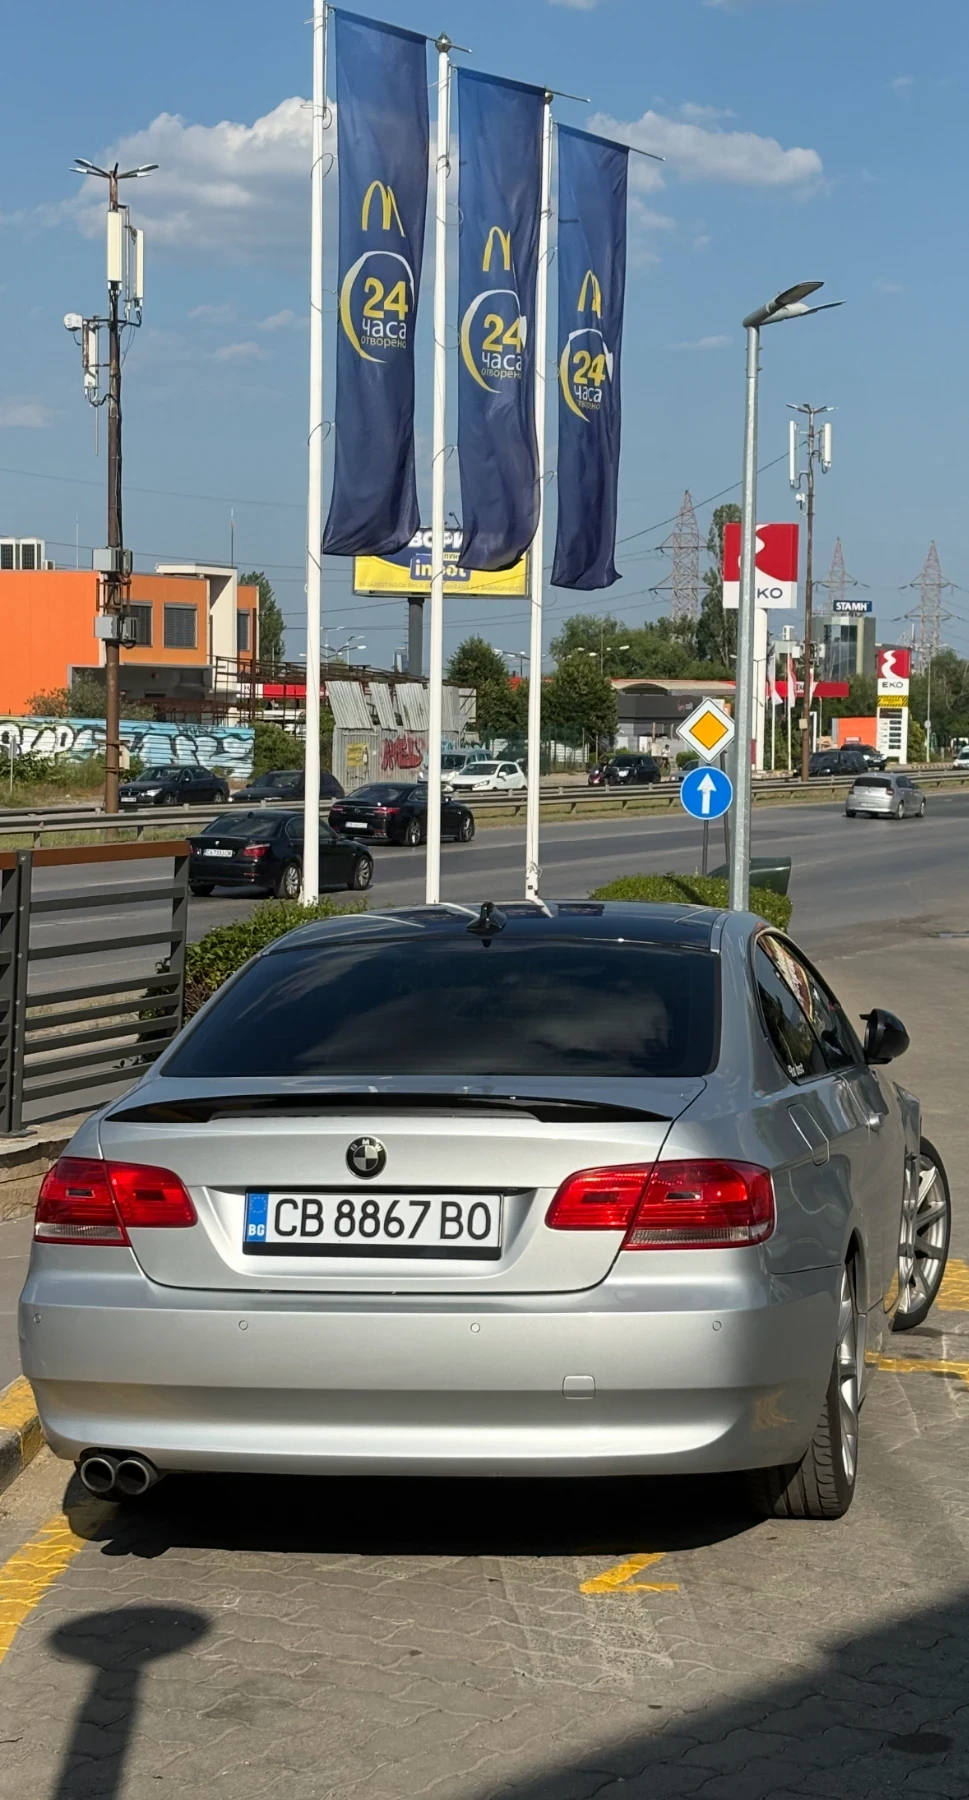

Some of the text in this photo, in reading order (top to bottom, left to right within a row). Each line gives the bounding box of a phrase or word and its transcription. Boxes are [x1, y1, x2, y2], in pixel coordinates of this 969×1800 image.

[363, 276, 409, 321] 24
[362, 318, 407, 340] часа
[482, 313, 522, 354] 24
[360, 335, 407, 350] отворено
[481, 367, 521, 381] отворен
[573, 350, 606, 387] 24
[574, 385, 603, 403] часа
[756, 587, 783, 599] KO
[836, 601, 868, 612] STAMH
[881, 681, 904, 689] EKO
[274, 1198, 325, 1238] CB
[334, 1199, 431, 1240] 8867
[248, 1224, 266, 1237] BG
